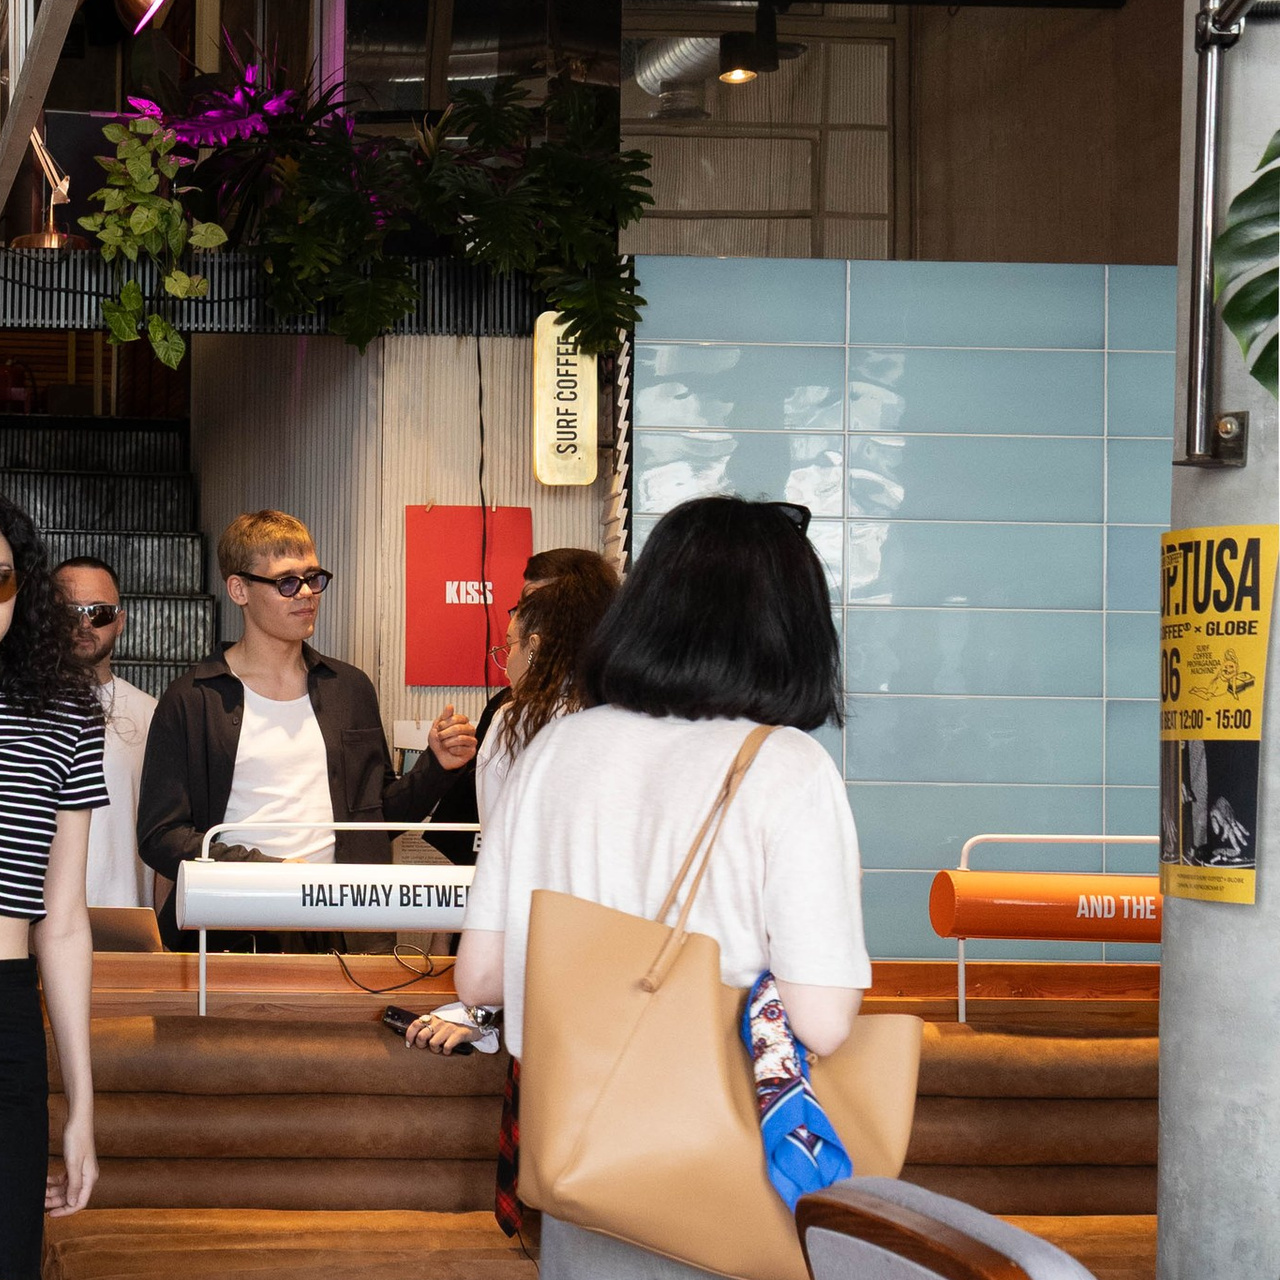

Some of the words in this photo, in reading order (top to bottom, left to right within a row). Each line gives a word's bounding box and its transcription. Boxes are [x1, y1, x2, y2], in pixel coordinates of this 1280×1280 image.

[556, 406, 578, 455] SURF
[445, 580, 494, 605] KISS
[1206, 620, 1258, 637] GLOBE
[1193, 652, 1213, 661] COFFEE
[1196, 644, 1209, 653] SURF
[1161, 647, 1181, 703] 06
[1187, 660, 1220, 668] PROPAGANDA
[1179, 708, 1204, 730] 12:00
[1215, 708, 1252, 730] 15:00
[301, 883, 393, 907] HALFWAY
[1076, 894, 1116, 919] AND
[1120, 895, 1157, 919] THE
